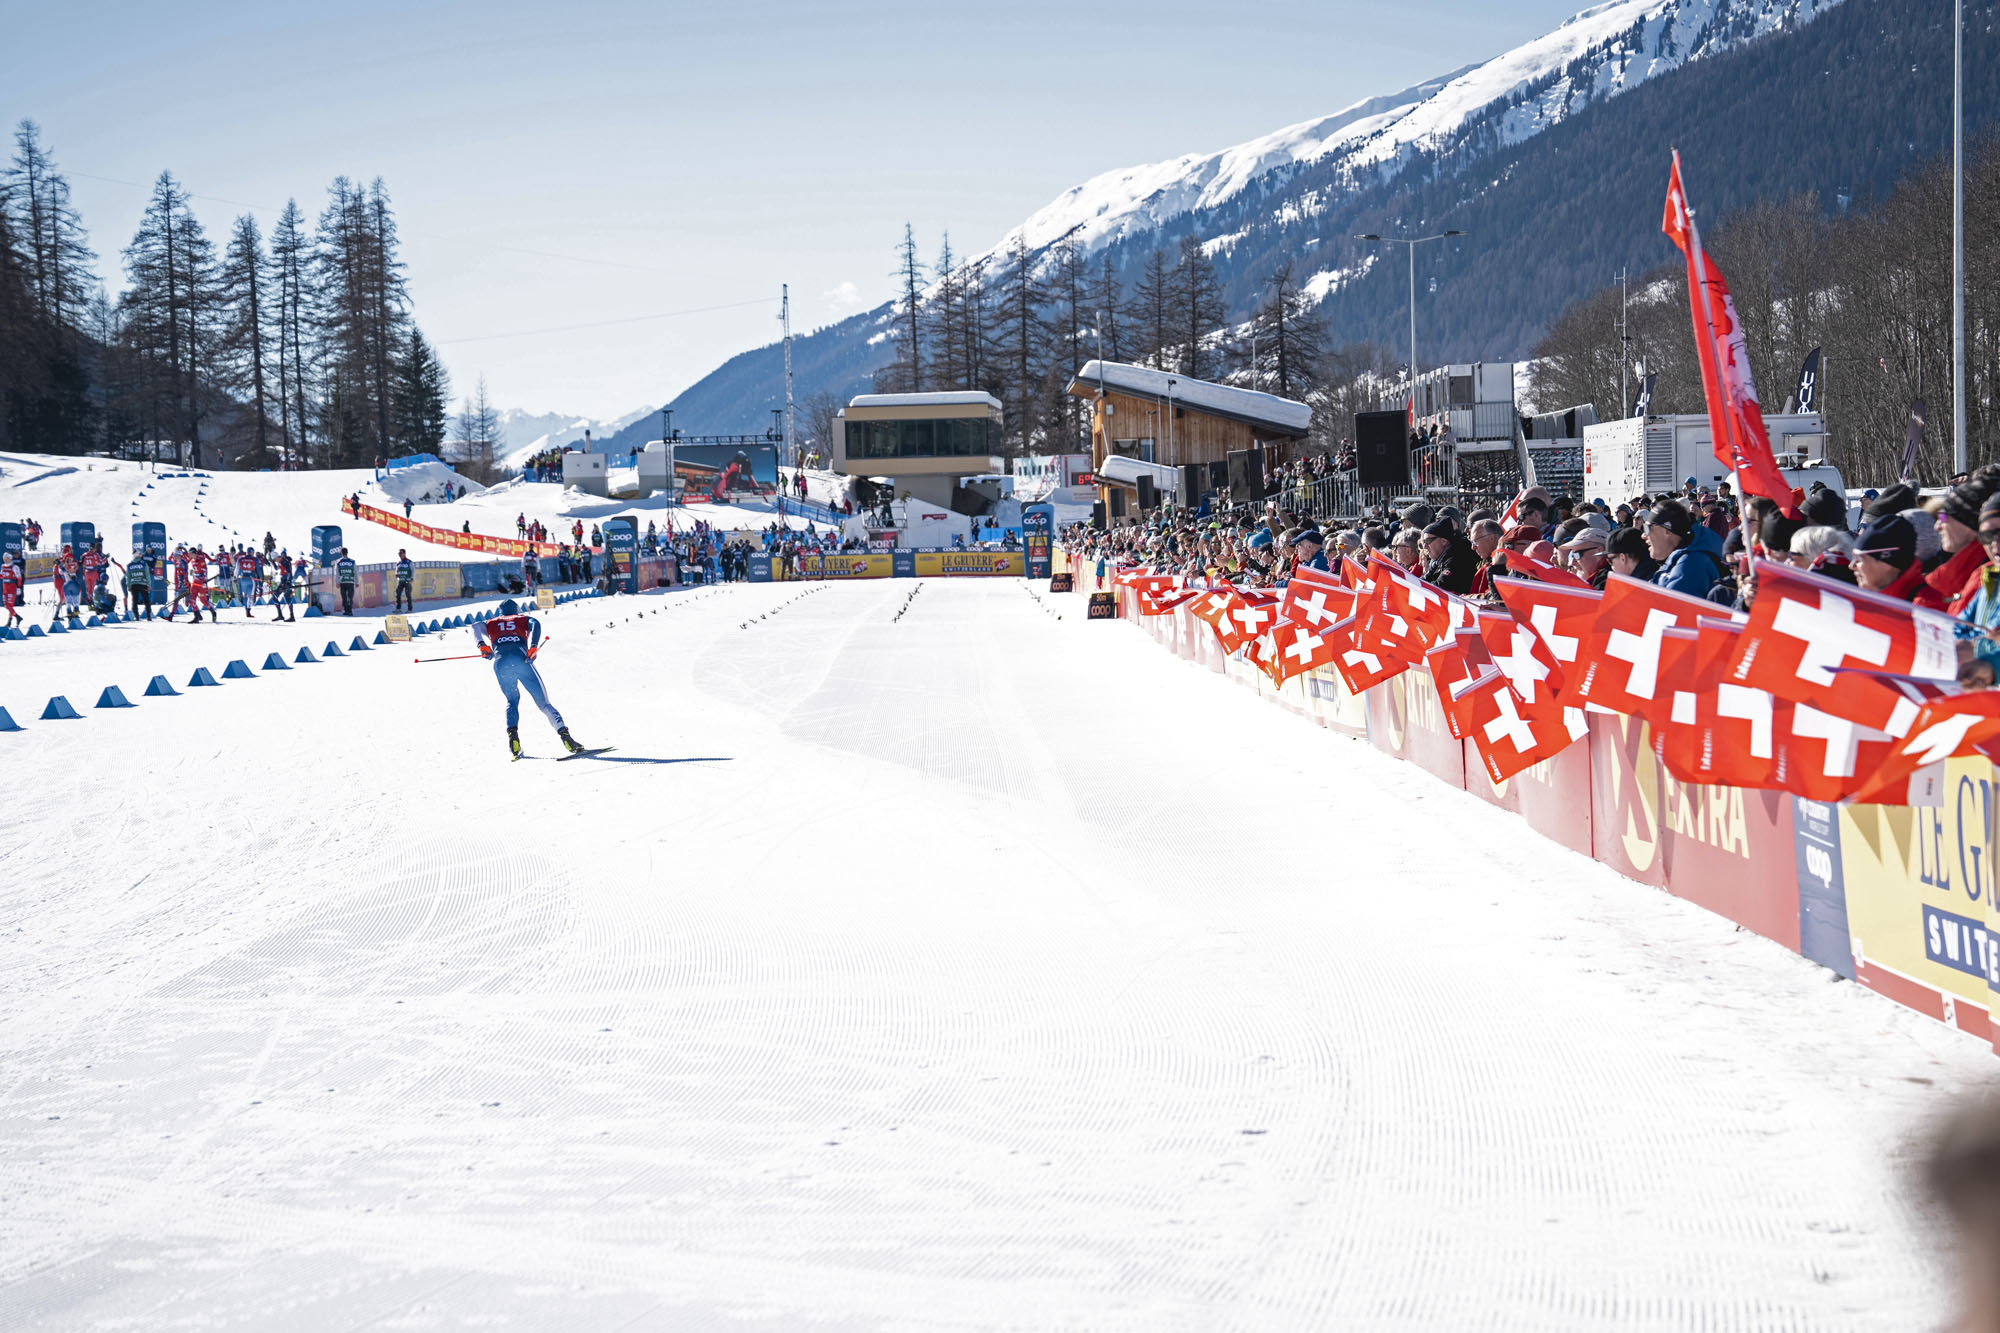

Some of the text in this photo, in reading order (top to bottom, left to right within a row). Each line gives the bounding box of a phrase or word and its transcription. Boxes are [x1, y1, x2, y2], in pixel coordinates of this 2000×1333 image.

[942, 555, 953, 566] LE
[1052, 582, 1070, 592] coop
[1096, 594, 1107, 602] 50m
[1091, 605, 1111, 617] coop
[497, 621, 516, 631] 15
[1664, 764, 1750, 860] EXTRA
